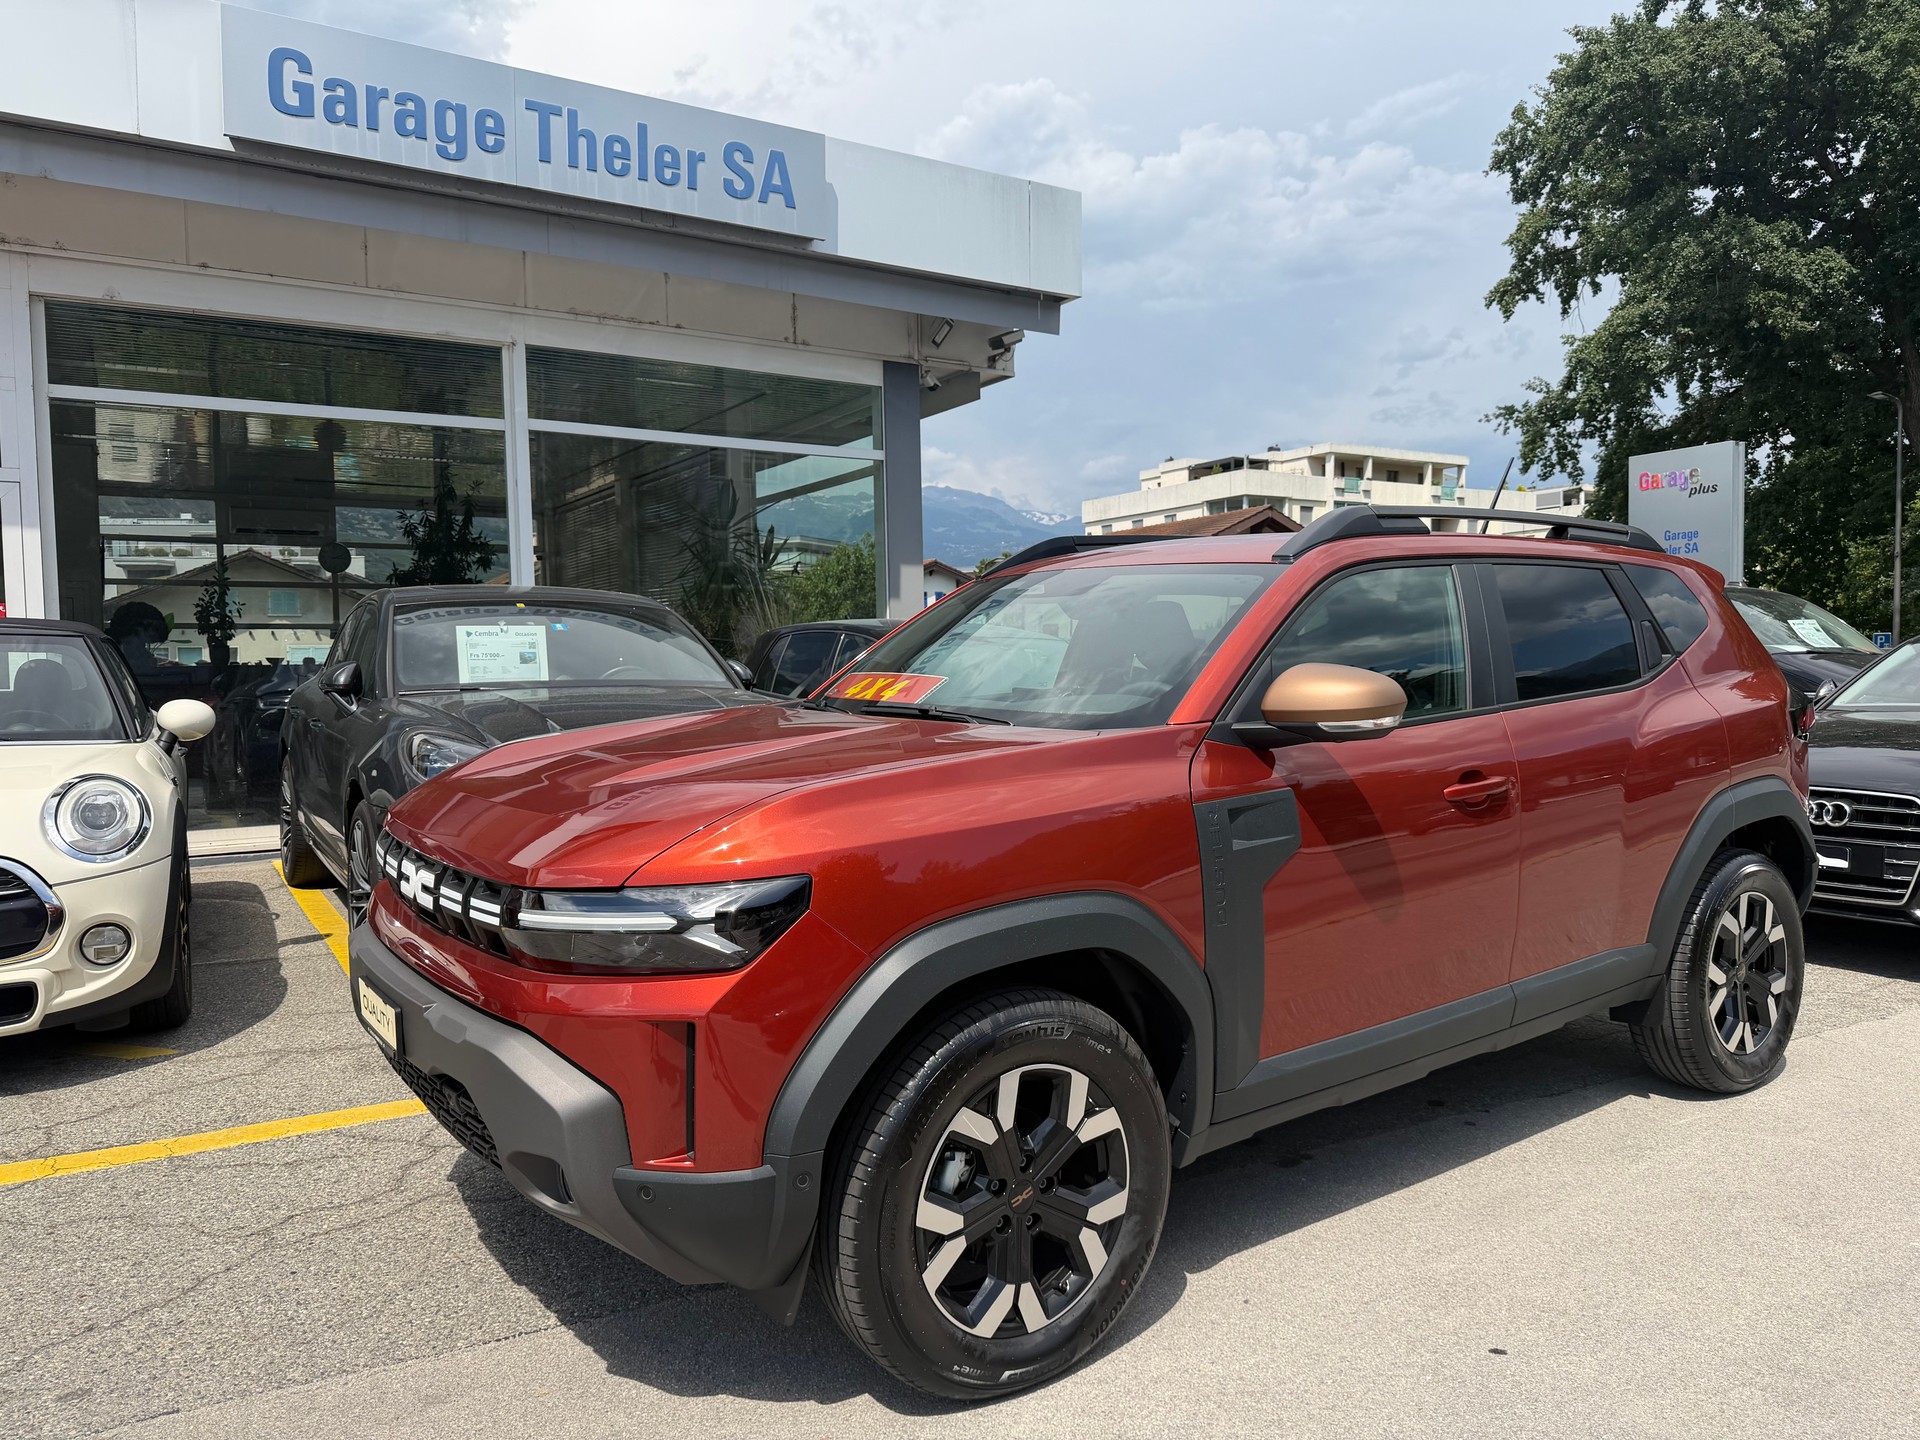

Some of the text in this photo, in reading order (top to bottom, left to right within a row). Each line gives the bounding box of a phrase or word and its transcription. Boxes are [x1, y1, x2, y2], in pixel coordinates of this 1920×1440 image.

[267, 46, 797, 209] Garage Theler SA
[1638, 467, 1700, 492] Garage
[1688, 482, 1718, 498] plus
[1664, 530, 1699, 541] Garage
[1684, 542, 1699, 554] SA
[1877, 636, 1885, 649] P
[363, 994, 391, 1032] QUALITY
